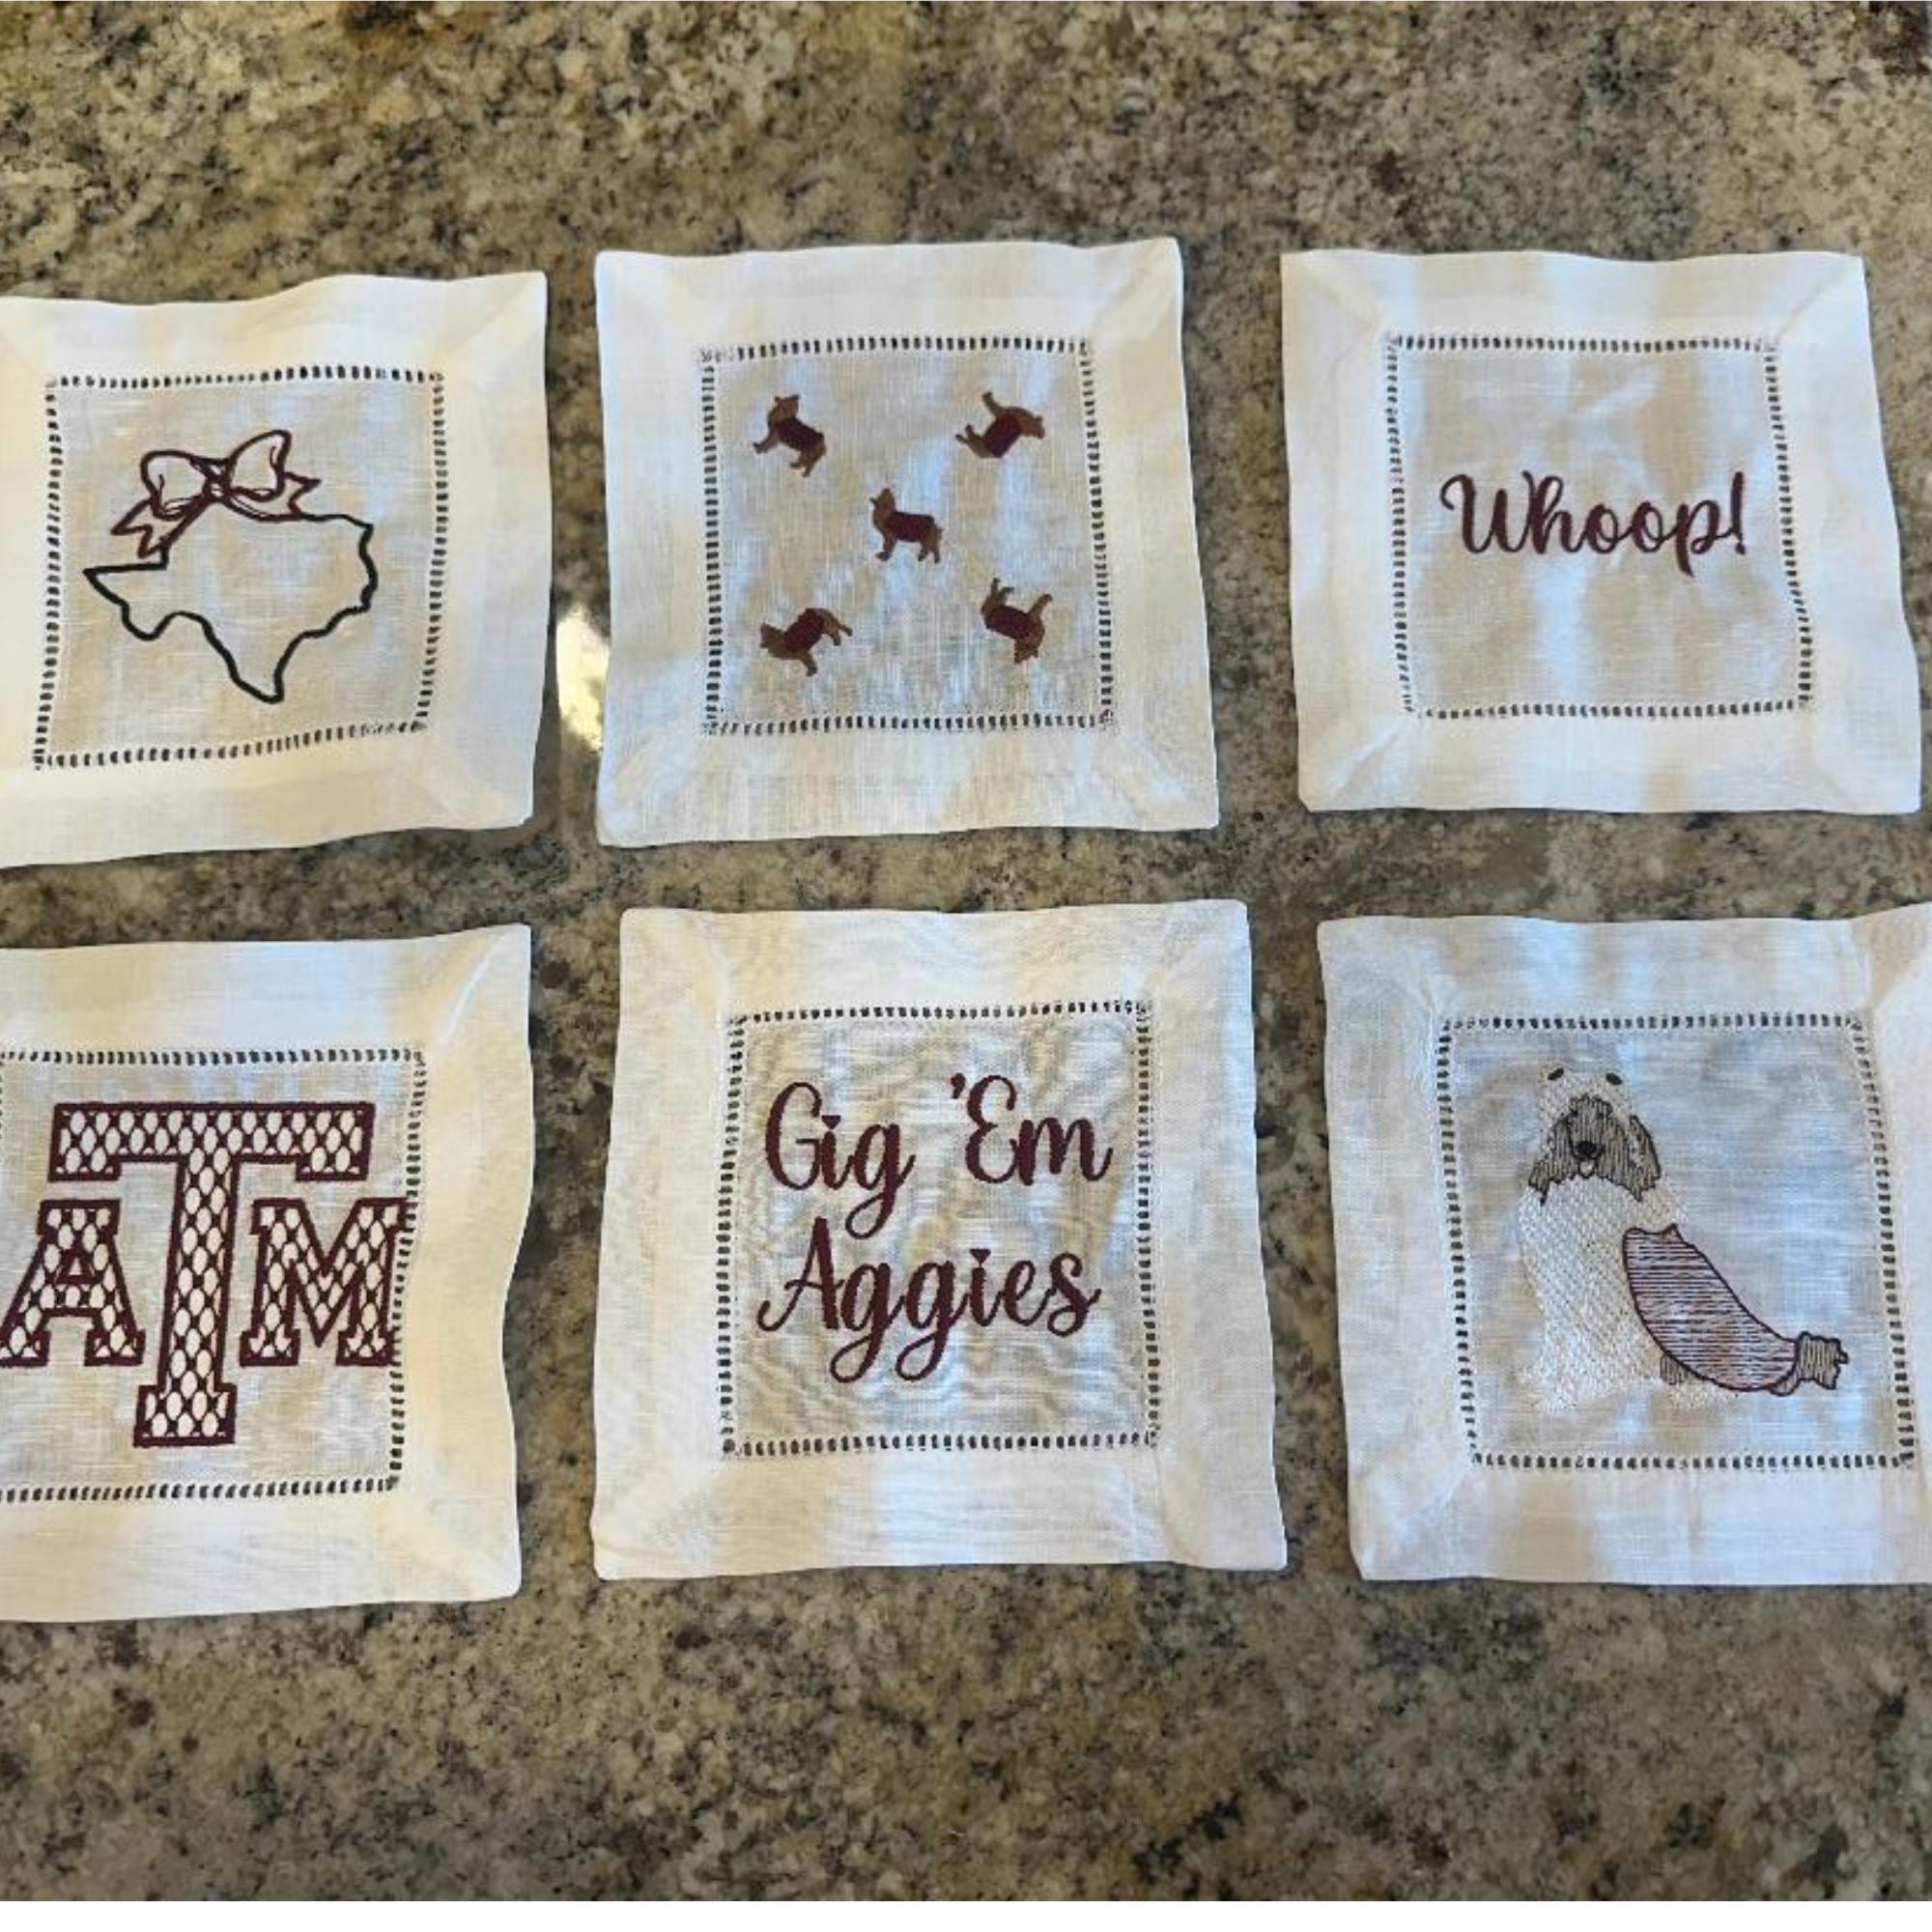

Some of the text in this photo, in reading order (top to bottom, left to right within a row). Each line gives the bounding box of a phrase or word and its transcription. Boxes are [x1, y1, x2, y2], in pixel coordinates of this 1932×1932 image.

[1439, 469, 1747, 578] Whoop!
[764, 1081, 917, 1239] Gig
[756, 1216, 1102, 1383] Aggies
